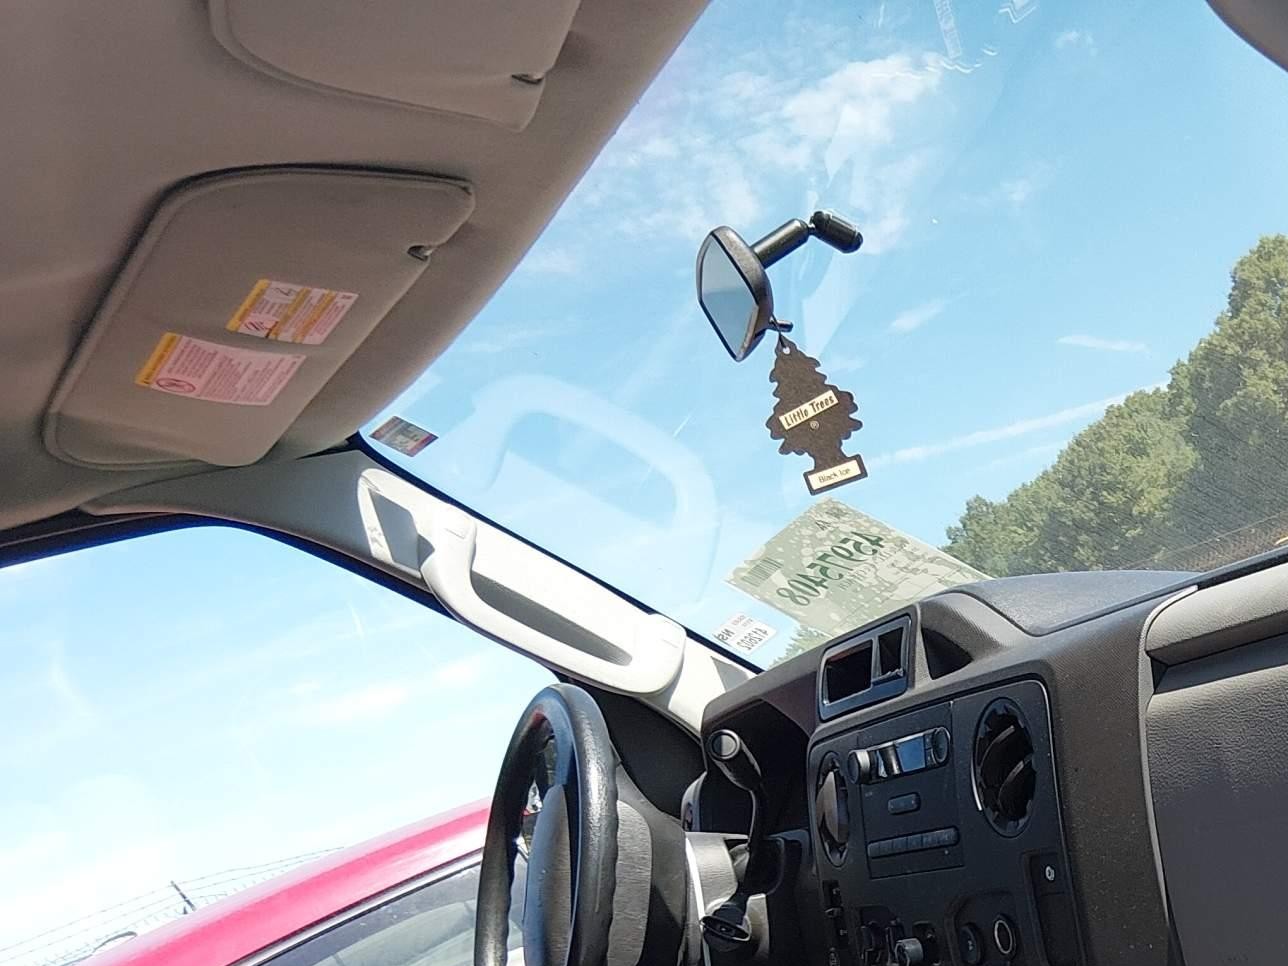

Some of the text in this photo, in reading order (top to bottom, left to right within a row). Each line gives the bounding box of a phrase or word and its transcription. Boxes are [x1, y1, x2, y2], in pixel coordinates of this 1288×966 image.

[783, 394, 835, 428] Little Trees
[818, 466, 851, 484] Black Ice
